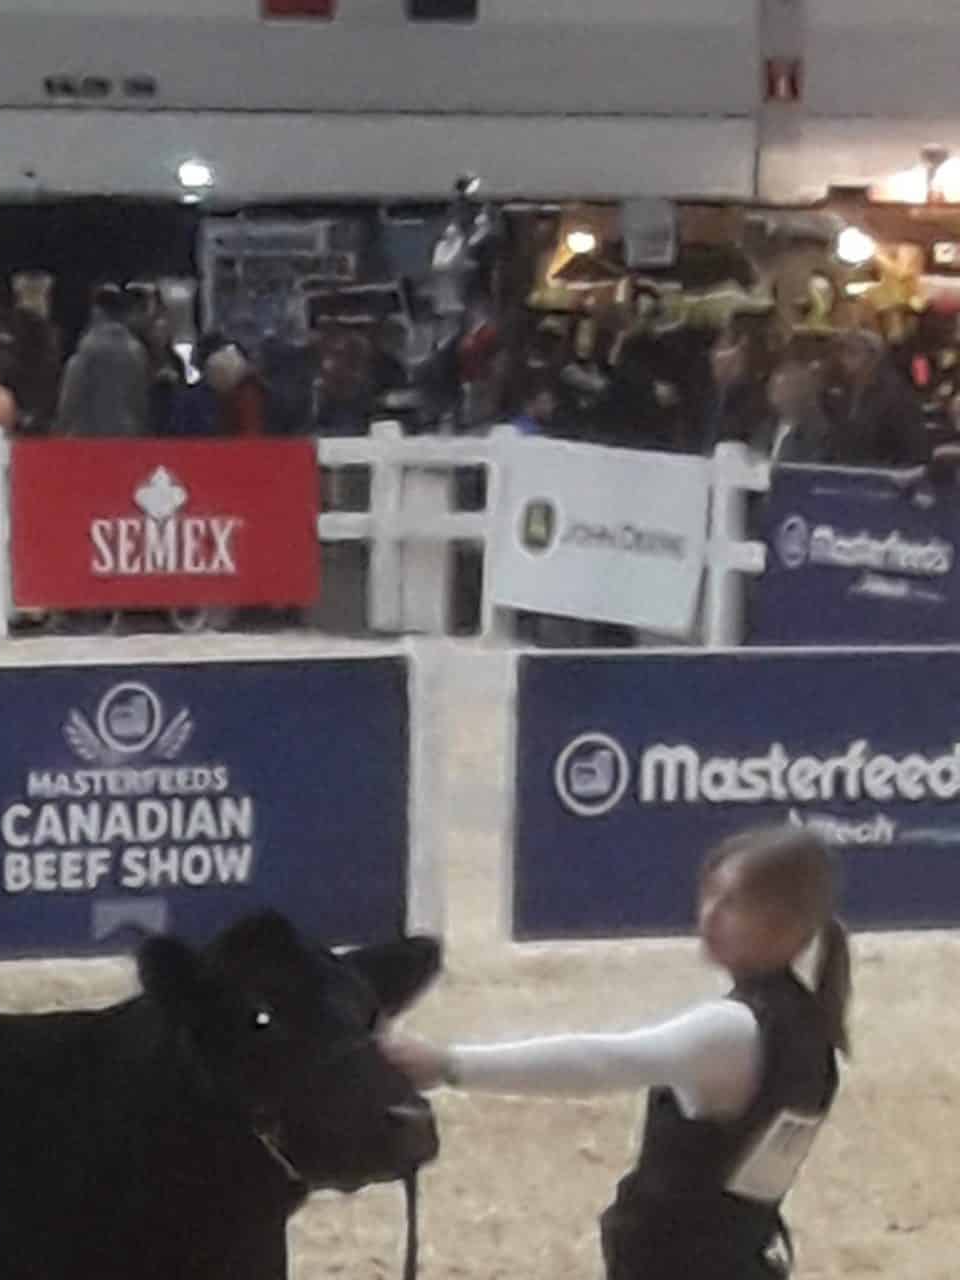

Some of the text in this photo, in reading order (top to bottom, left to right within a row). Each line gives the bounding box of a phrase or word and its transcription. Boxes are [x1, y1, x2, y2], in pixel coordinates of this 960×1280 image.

[89, 517, 238, 575] SEMEX
[26, 766, 229, 797] MASTERFEEDS
[1, 796, 253, 848] CANADIAN
[3, 844, 253, 893] BEEF SHOW
